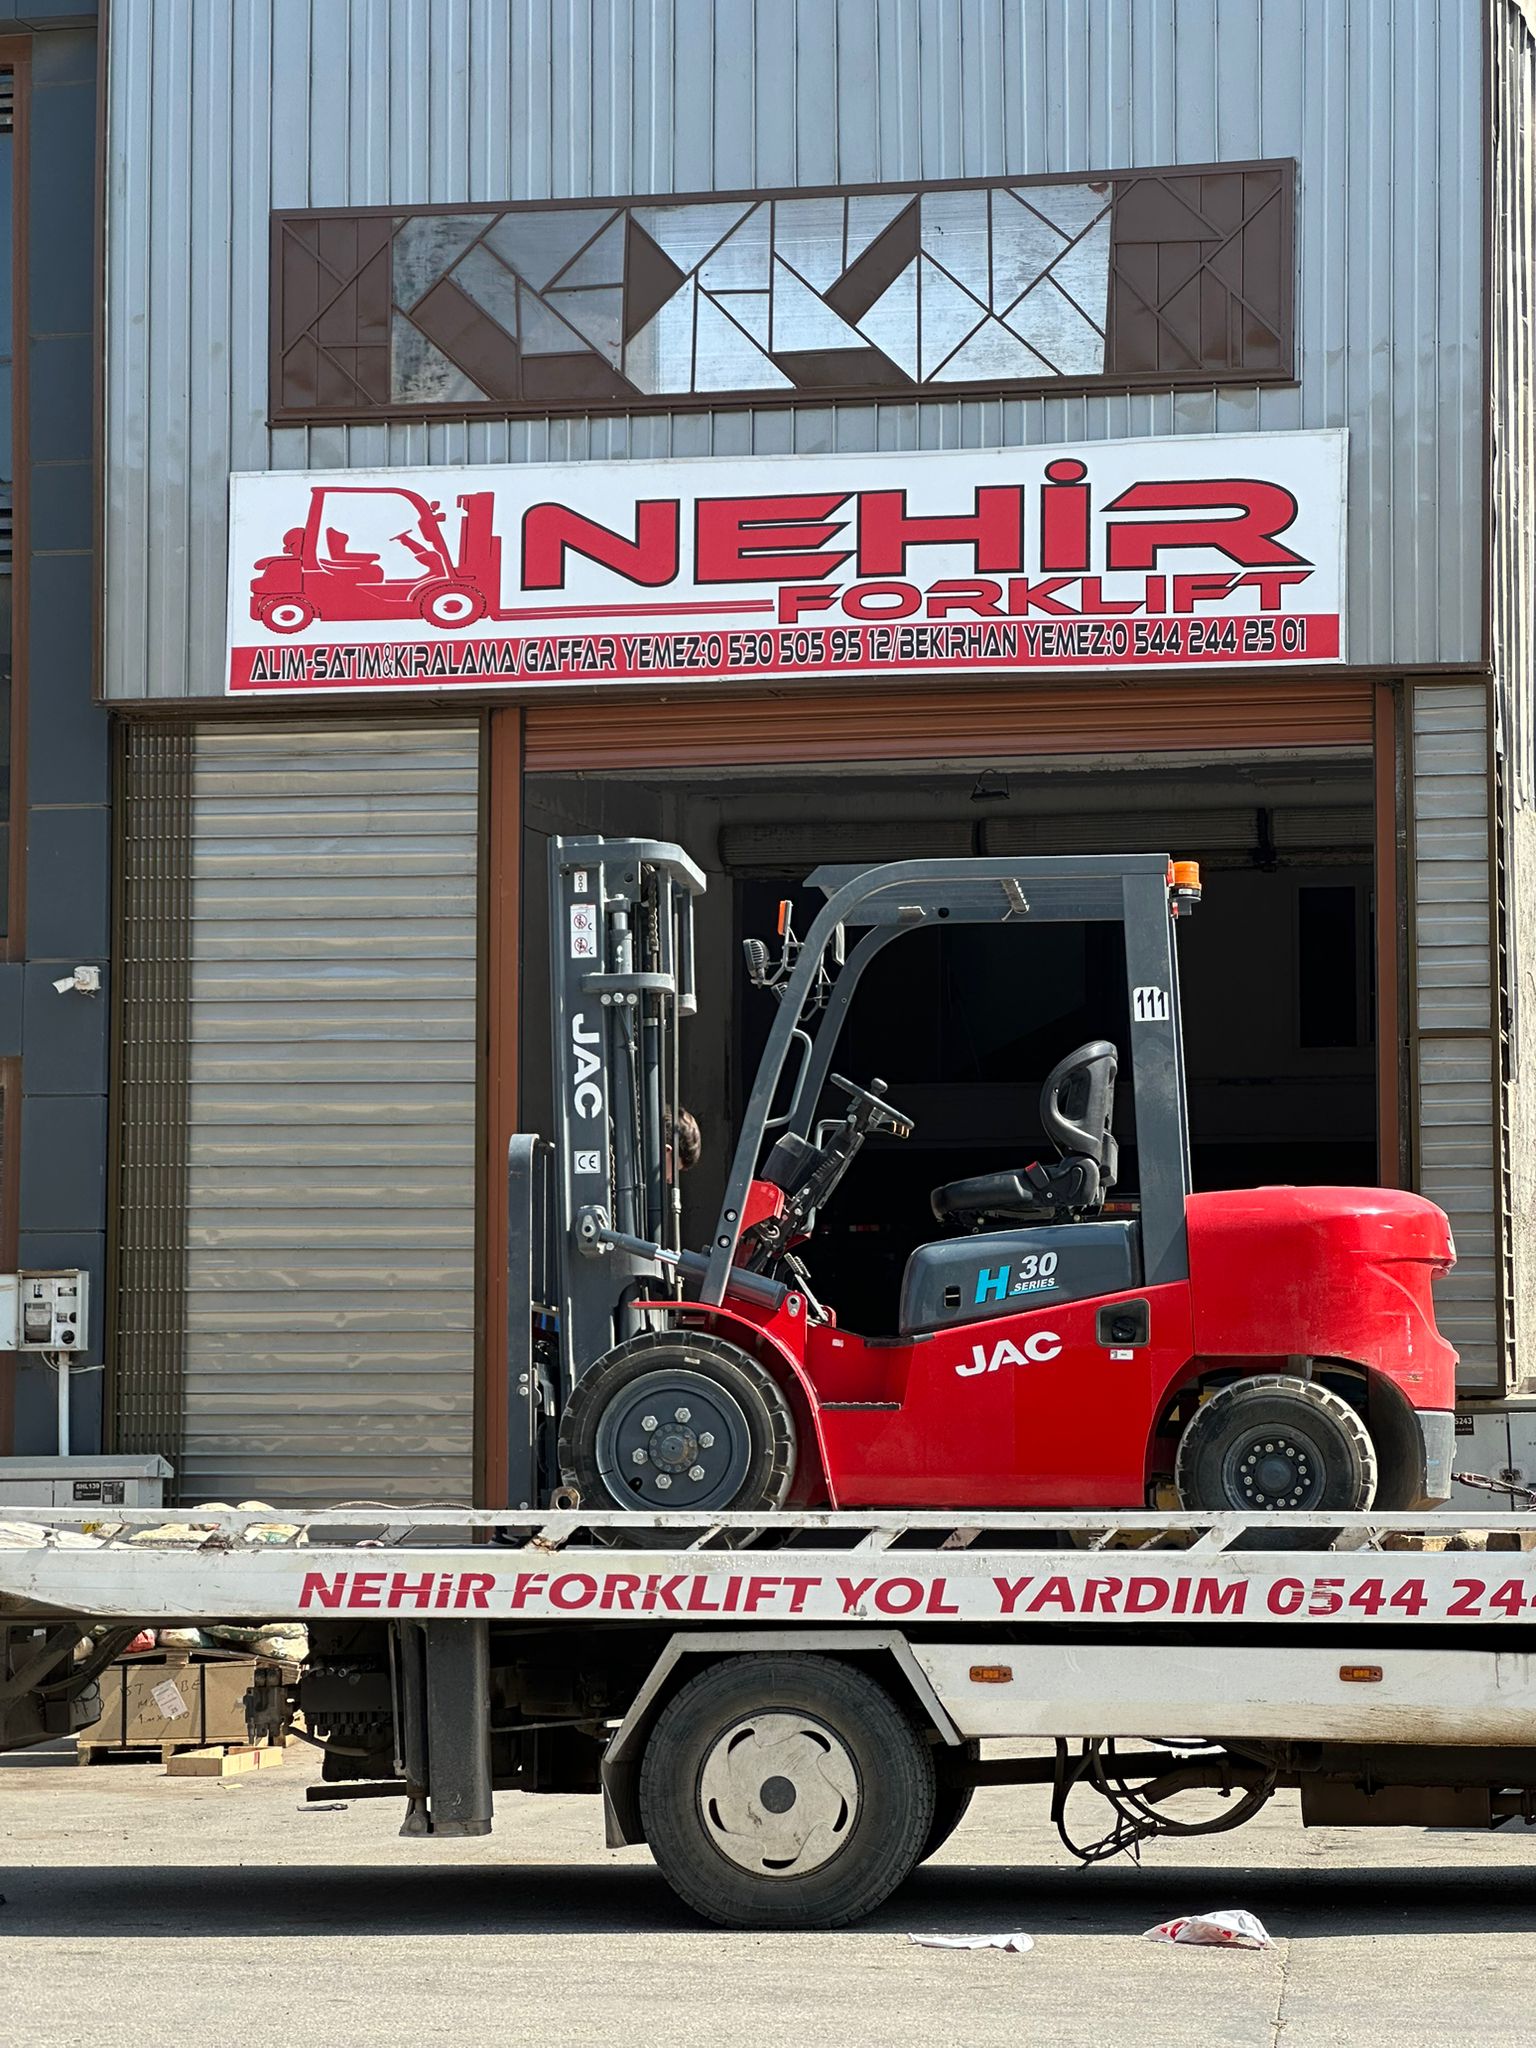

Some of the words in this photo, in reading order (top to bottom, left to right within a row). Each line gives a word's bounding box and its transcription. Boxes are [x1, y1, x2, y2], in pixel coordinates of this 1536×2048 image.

[778, 569, 1315, 625] FORKLIFT
[728, 632, 773, 667] 530
[778, 628, 825, 665] 505
[830, 627, 862, 662] 95
[1134, 620, 1183, 656] 544
[1188, 618, 1239, 655] 244
[1244, 618, 1276, 653] 25
[1281, 617, 1307, 653] 01
[1137, 989, 1166, 1019] 111
[571, 1013, 603, 1120] JAC
[975, 1265, 1011, 1304] H
[1019, 1251, 1058, 1280] 30
[1014, 1277, 1055, 1292] SERIES
[954, 1331, 1063, 1377] JAC
[511, 1573, 823, 1613] FORKLIFT
[837, 1577, 959, 1615] YOL
[993, 1576, 1249, 1616] YARDIM
[1267, 1578, 1428, 1616] 0544
[1446, 1579, 1536, 1616] 24
